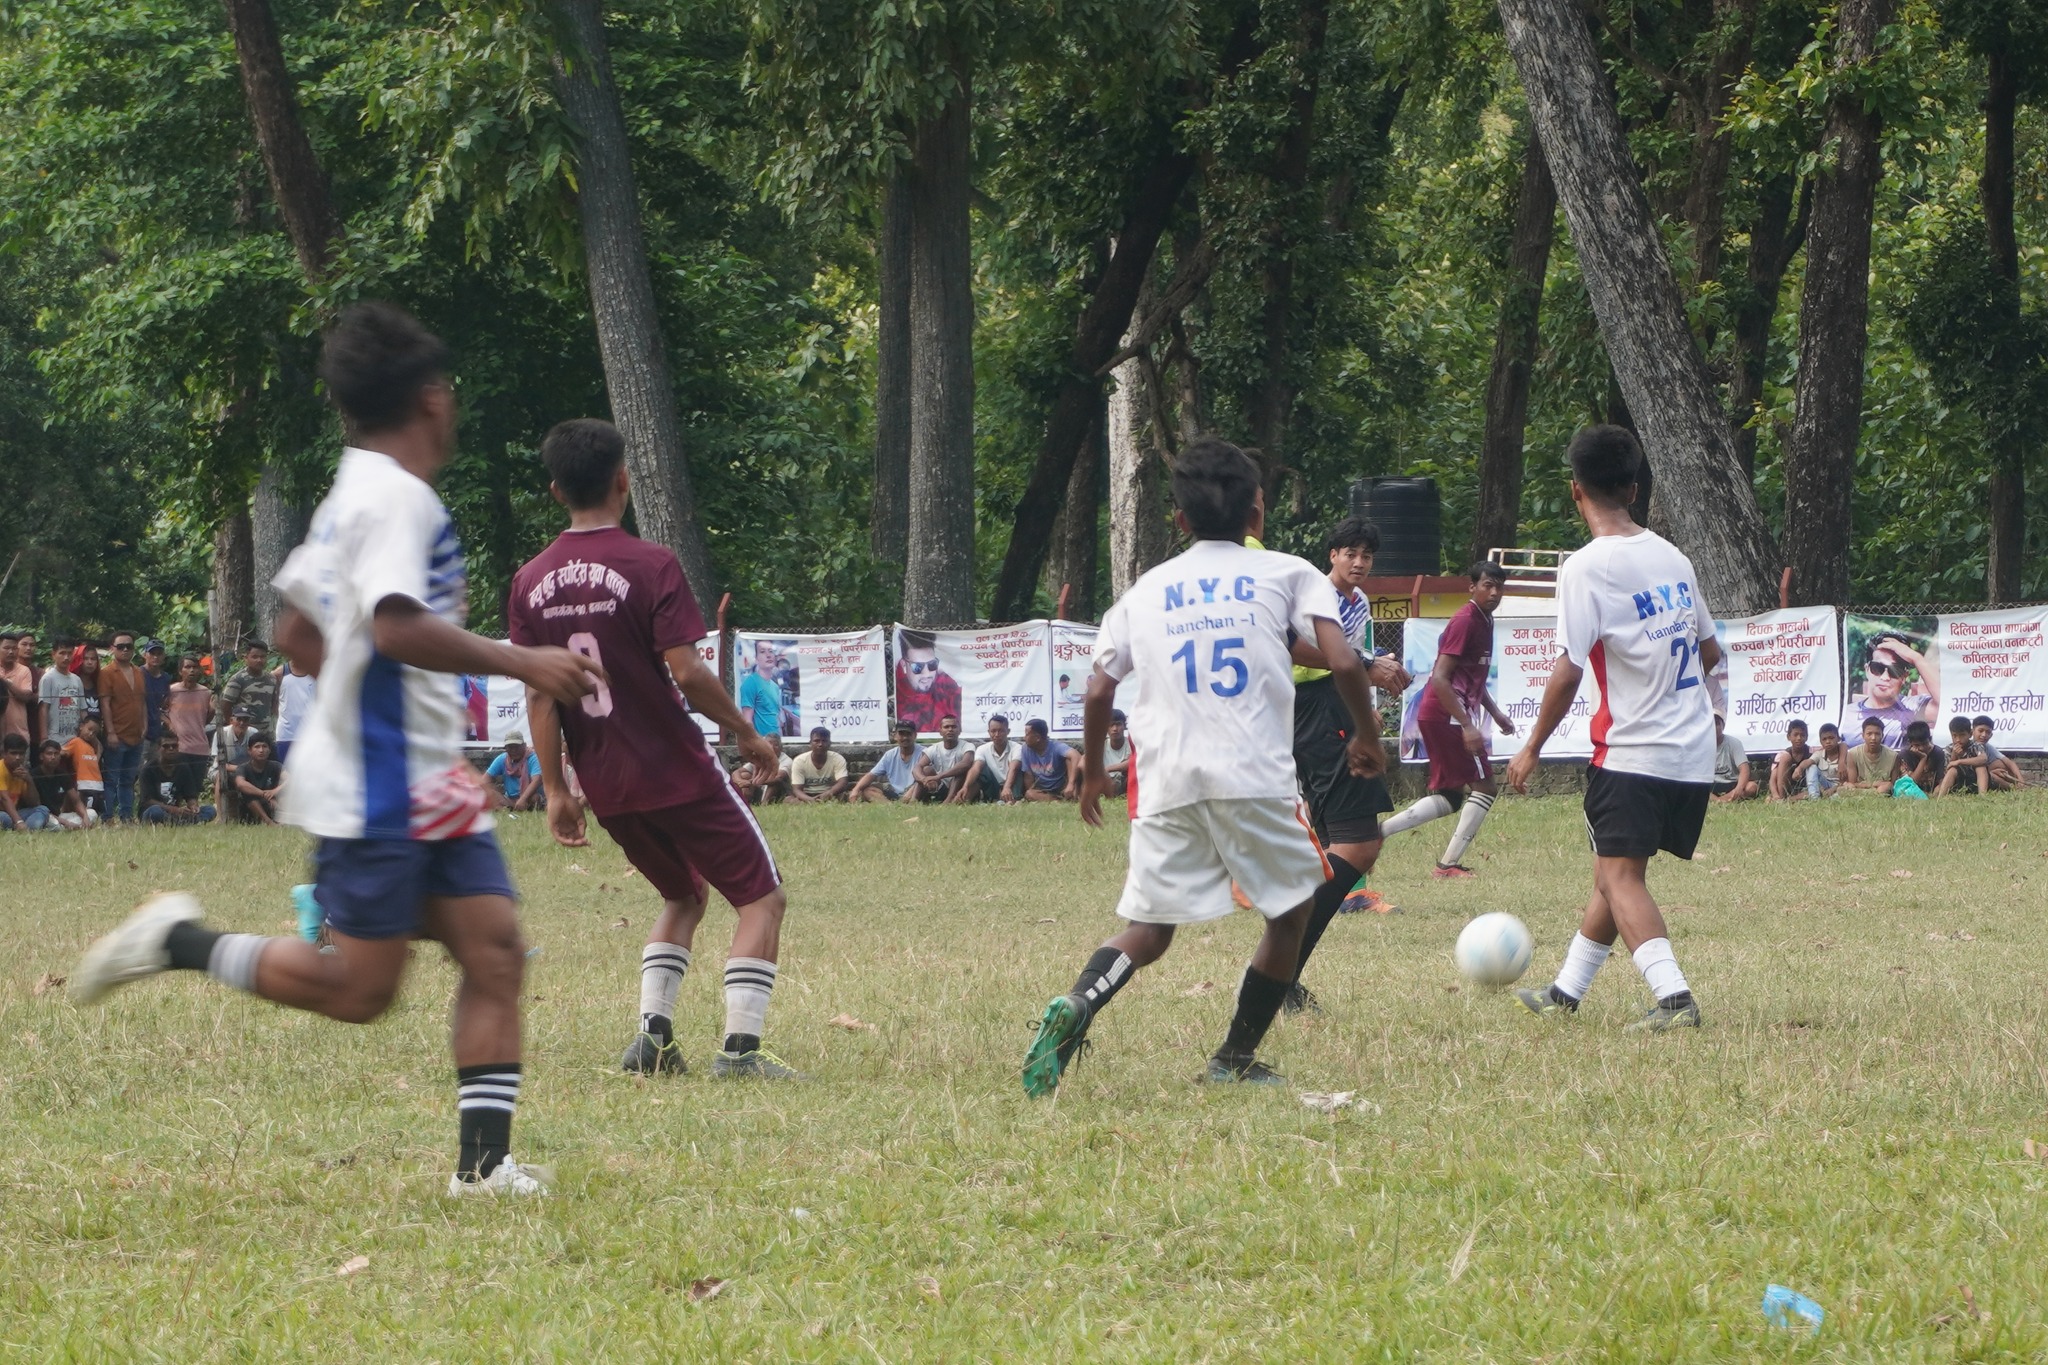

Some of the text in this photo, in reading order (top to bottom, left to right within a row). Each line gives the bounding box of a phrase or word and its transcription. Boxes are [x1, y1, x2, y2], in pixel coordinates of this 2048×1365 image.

[1166, 615, 1235, 636] kanchan
[1512, 628, 1530, 640] यम
[1171, 637, 1249, 698] 15
[1789, 653, 1811, 666] हाल
[813, 696, 882, 712] आर्थिक सहयोग
[975, 692, 1043, 707] आर्थिक सहयोग
[1735, 689, 1828, 716] आर्थिक सहयोग
[1951, 689, 2045, 714] आर्थिक सहयोग
